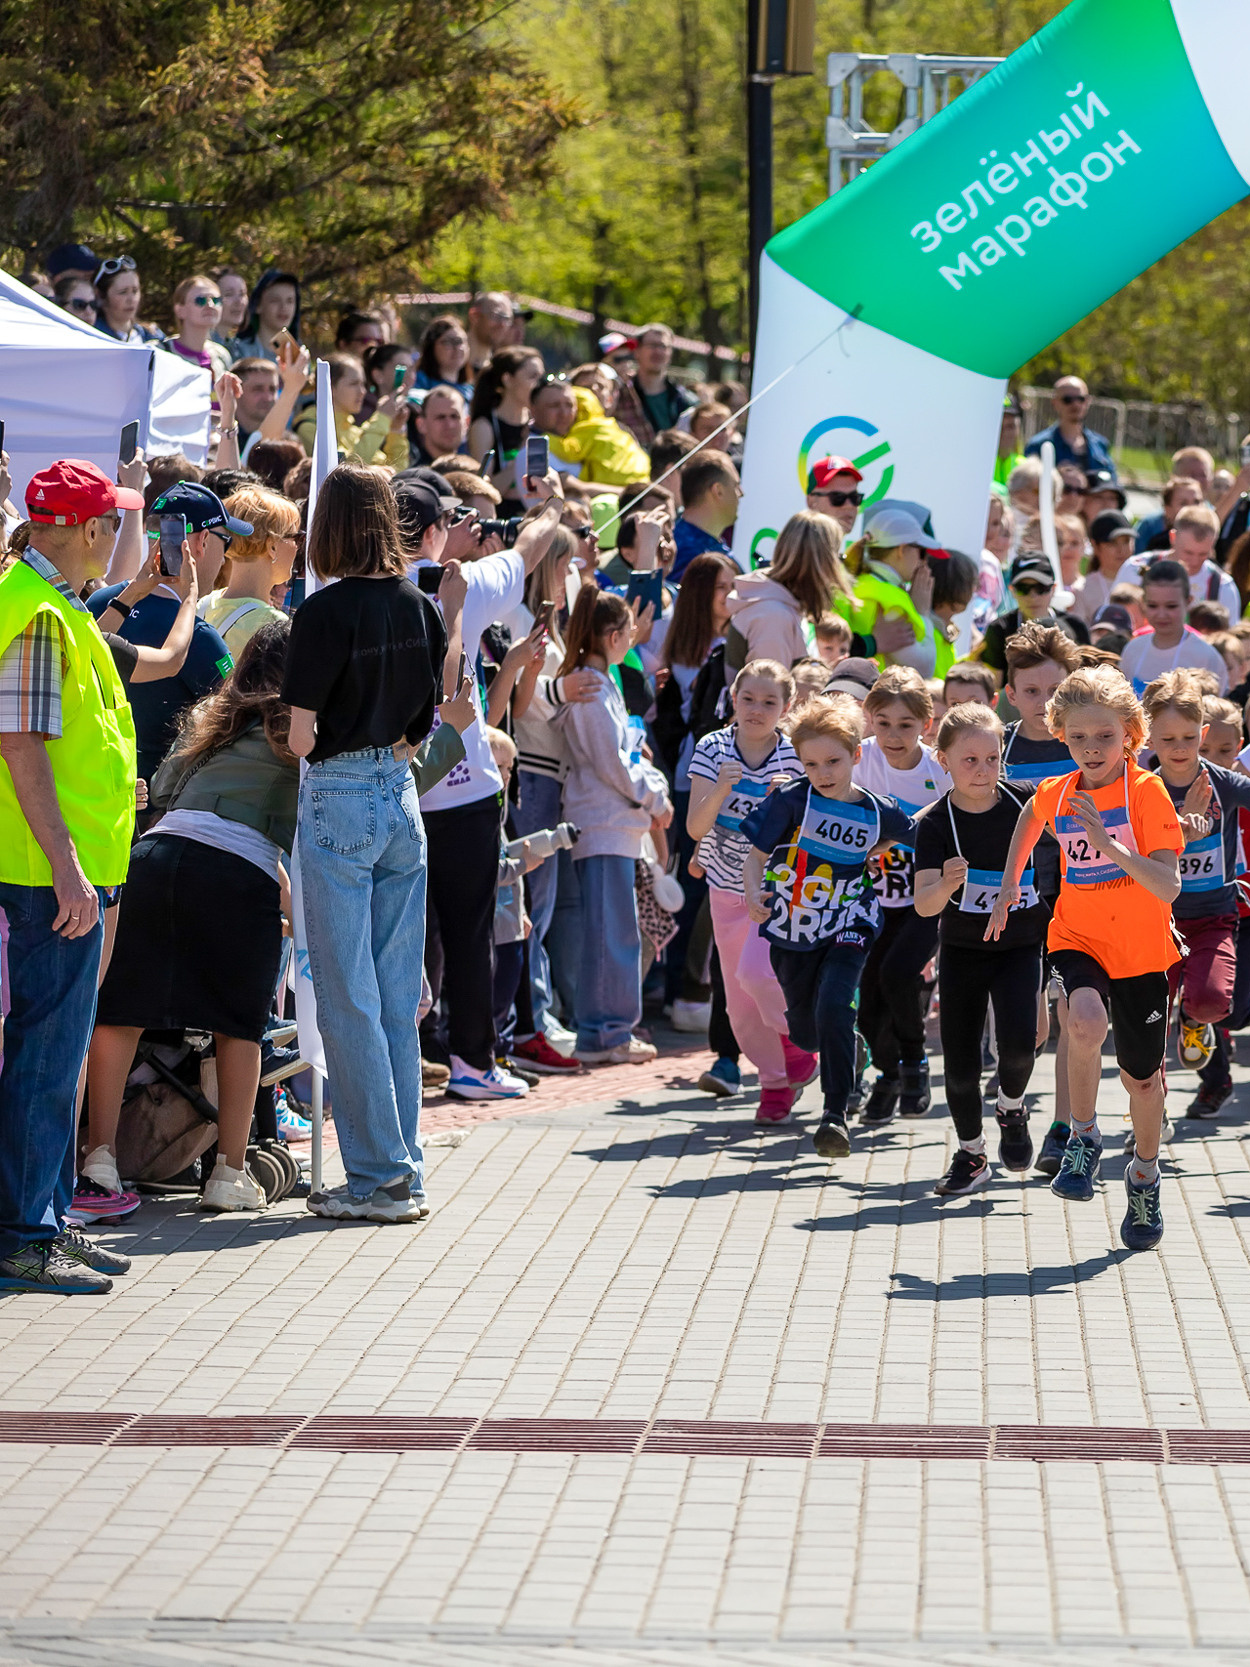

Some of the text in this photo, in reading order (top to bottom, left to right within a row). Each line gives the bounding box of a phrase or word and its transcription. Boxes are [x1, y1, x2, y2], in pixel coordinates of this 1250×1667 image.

[910, 81, 1111, 253] зелёный
[938, 129, 1142, 291] марафон
[815, 819, 868, 848] 4065
[773, 863, 866, 910] 2GIS
[766, 896, 879, 944] 2RUN
